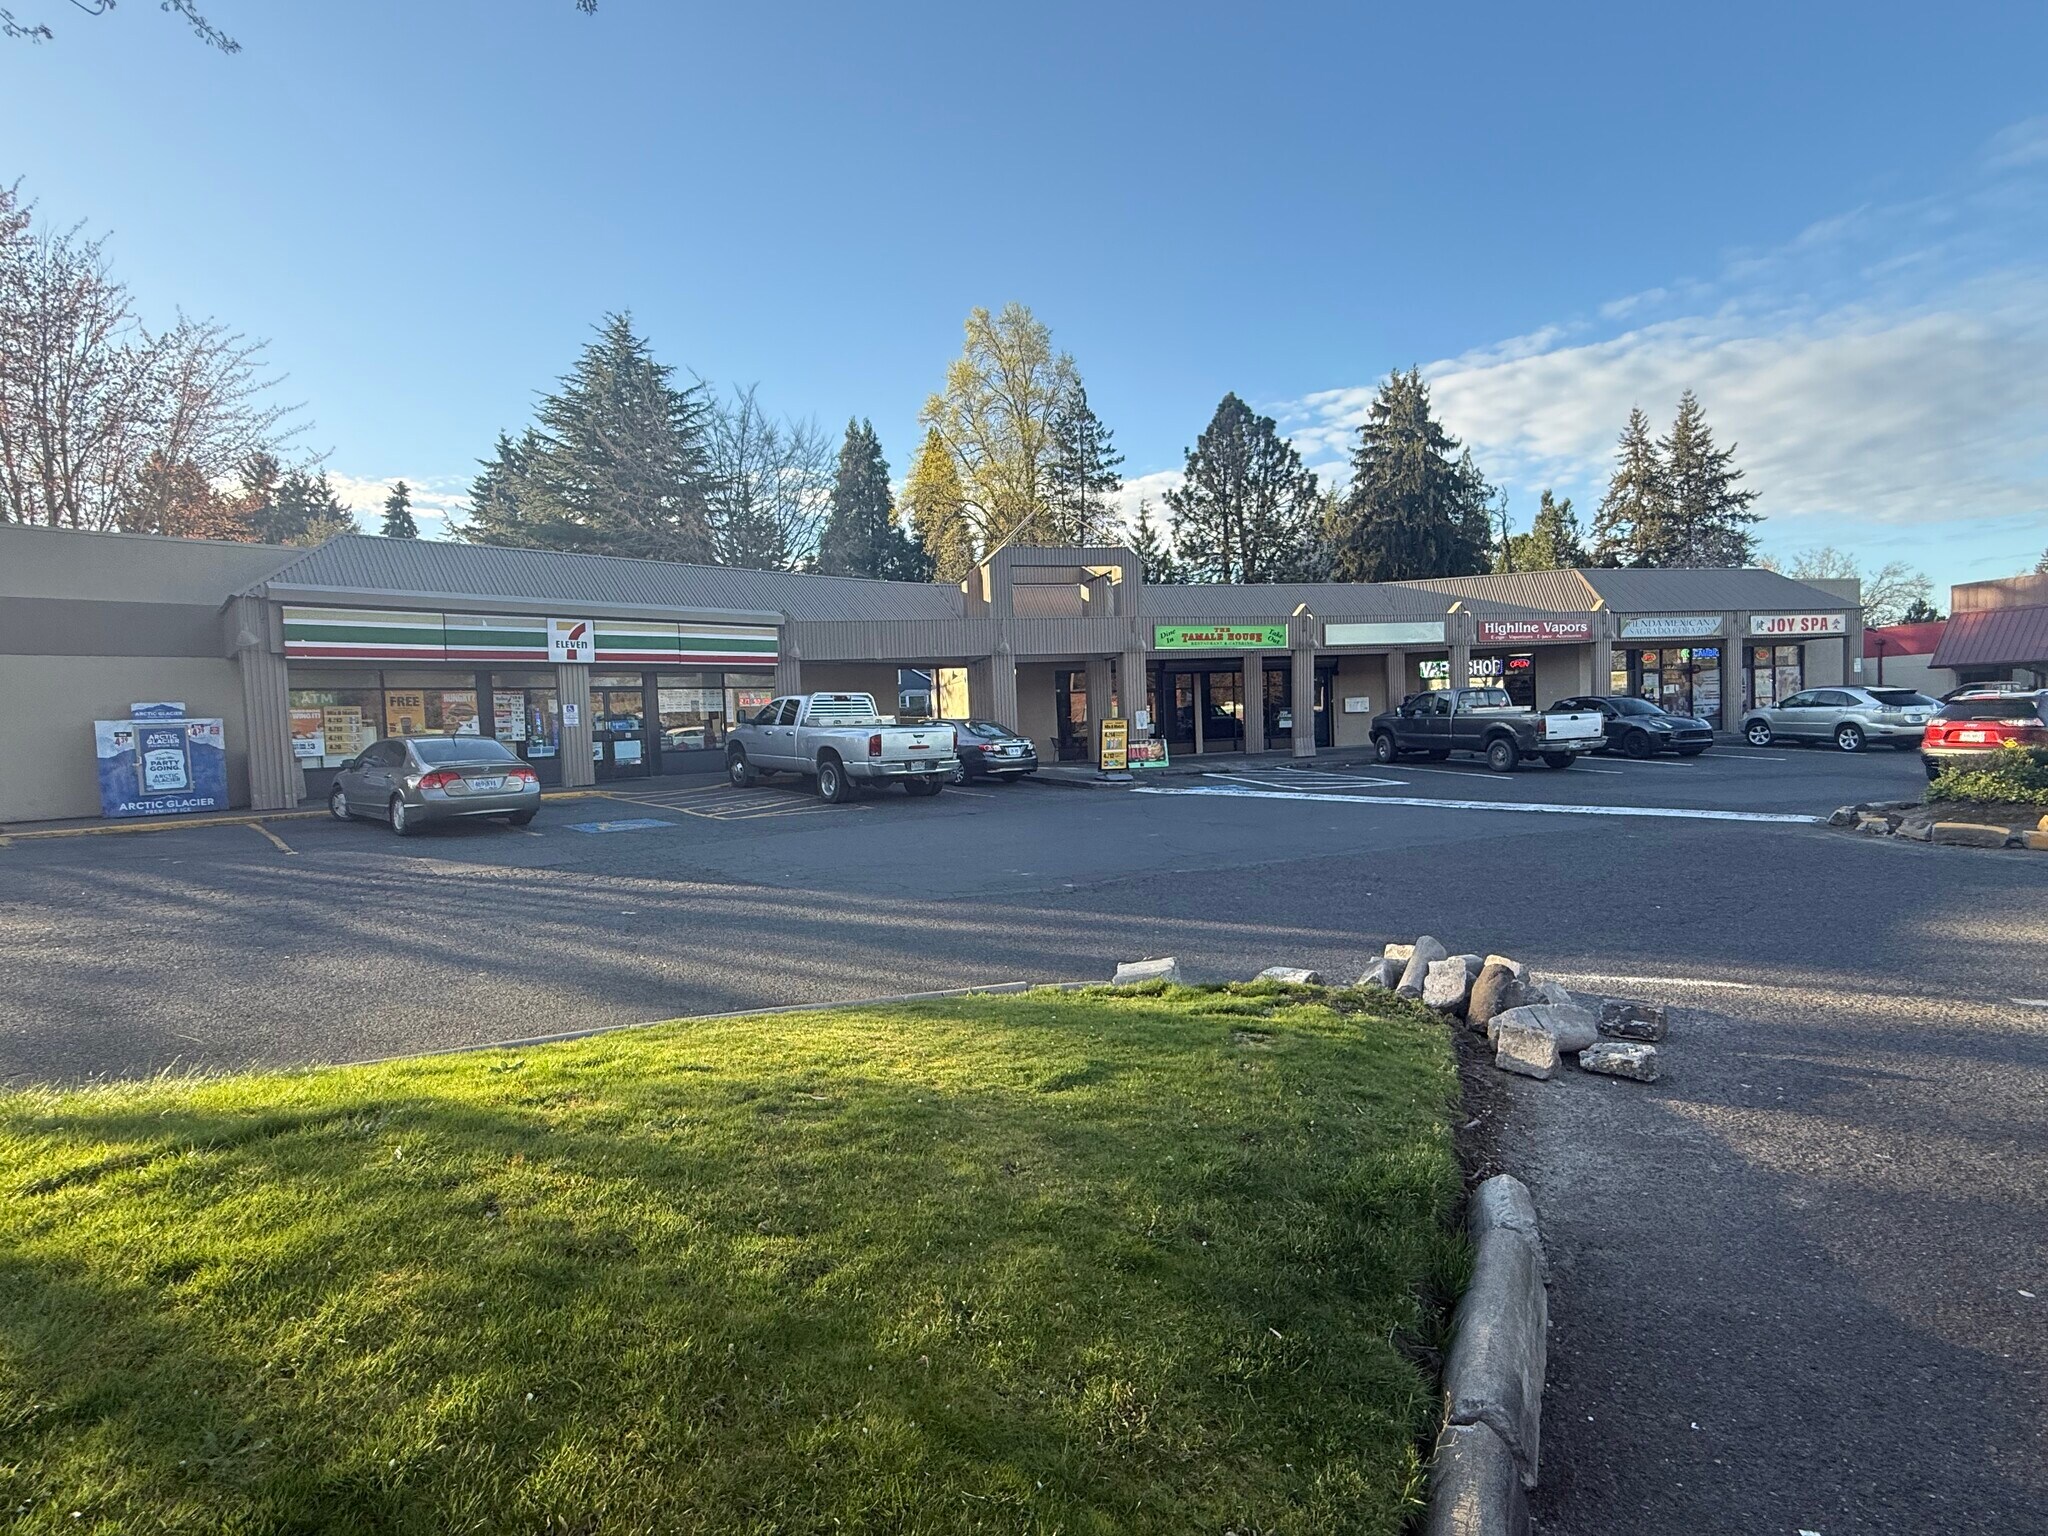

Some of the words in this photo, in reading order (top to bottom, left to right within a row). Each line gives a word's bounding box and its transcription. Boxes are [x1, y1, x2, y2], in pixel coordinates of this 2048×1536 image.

[1664, 619, 1717, 627] MEXICANA
[1767, 618, 1795, 632] JOY
[1801, 617, 1828, 631] SPA
[1268, 628, 1283, 638] Take
[1485, 622, 1539, 635] Highline
[1543, 622, 1588, 634] Vapors
[1160, 629, 1176, 639] Dine
[1182, 633, 1224, 642] TAMALE
[1227, 633, 1262, 642] HOUSE
[1267, 635, 1280, 644] Out
[1509, 660, 1529, 668] OPEN
[1419, 661, 1450, 678] VAP
[301, 692, 333, 704] ATM
[389, 696, 420, 707] FREE
[119, 800, 164, 811] ARCTIC
[166, 797, 215, 808] GLACIER
